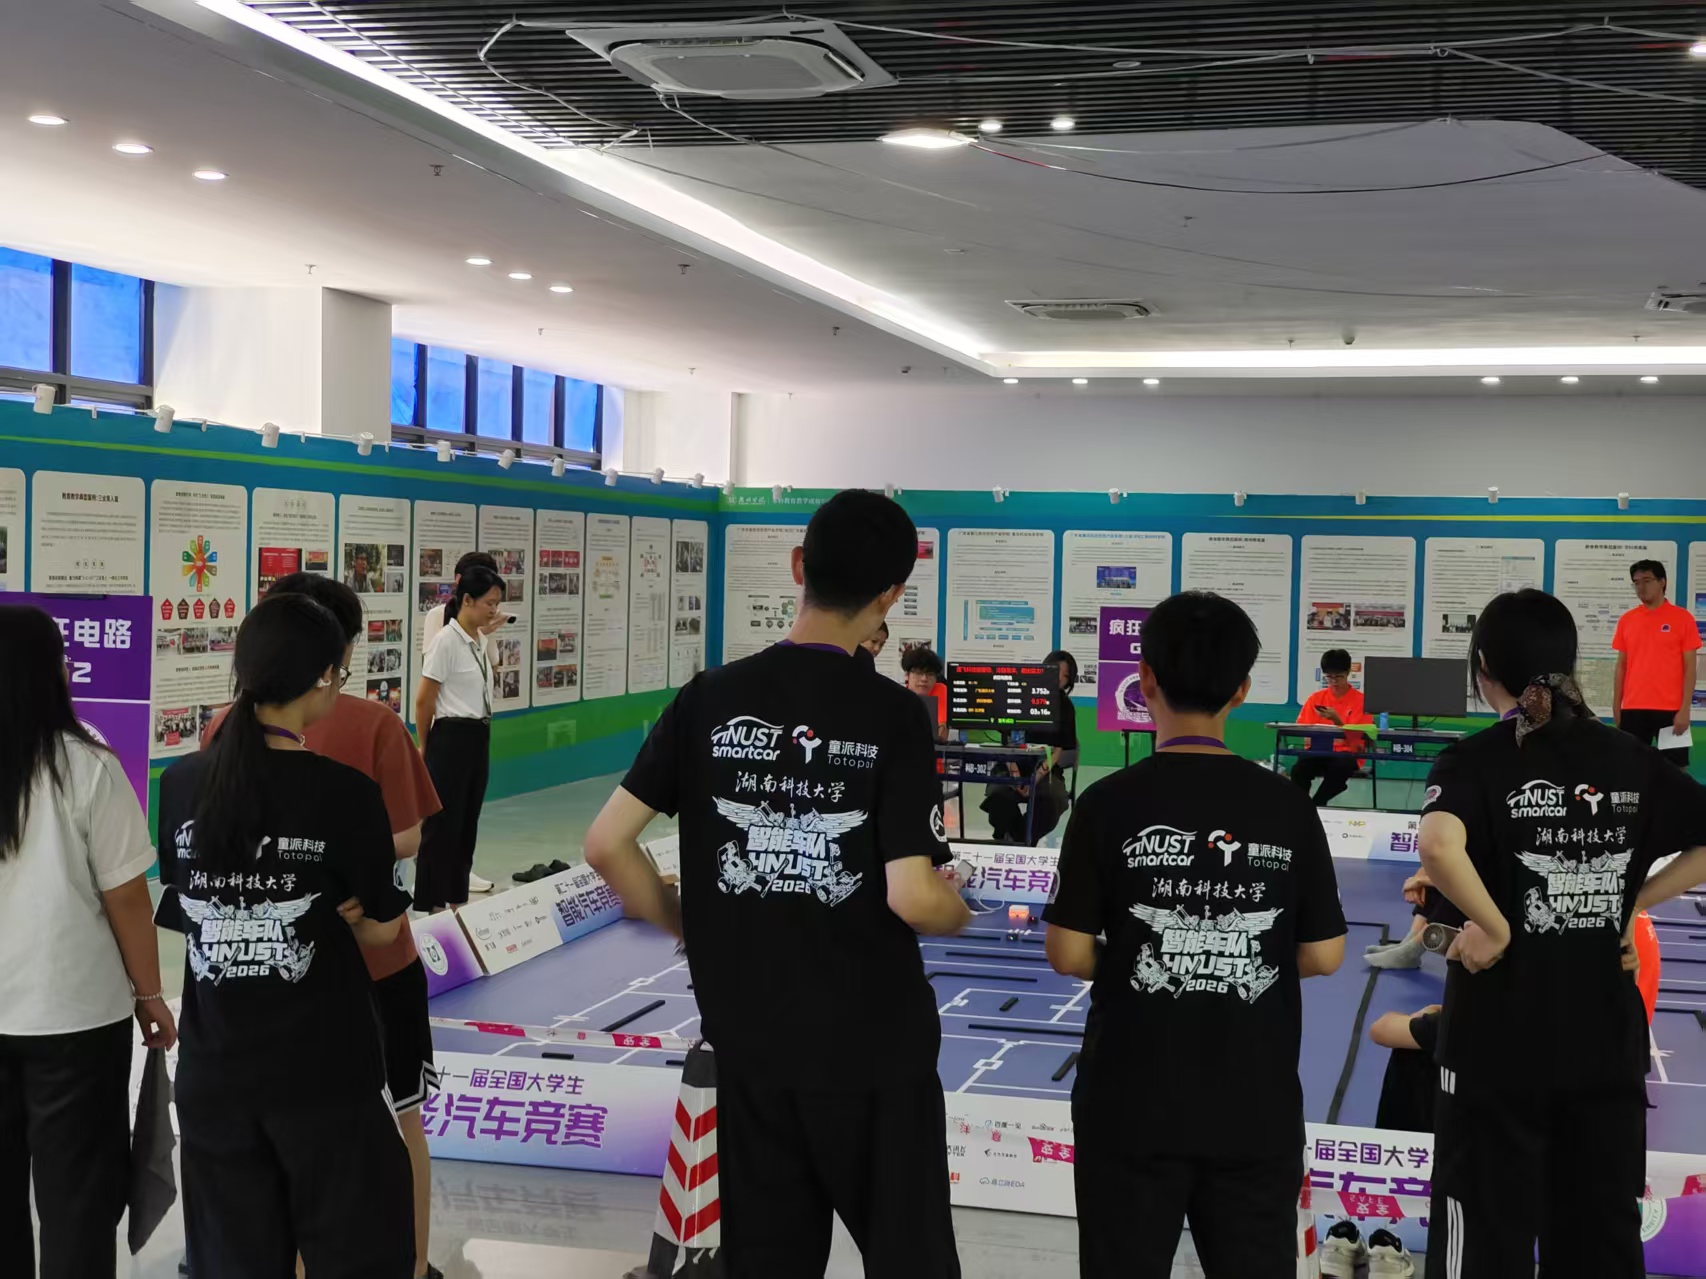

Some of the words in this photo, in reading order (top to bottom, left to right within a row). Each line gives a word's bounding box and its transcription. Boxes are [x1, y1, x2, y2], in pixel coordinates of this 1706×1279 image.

[712, 746, 780, 761] smartcar
[828, 740, 879, 760] 童派科技
[735, 770, 846, 803] 湖南科技大学
[1610, 791, 1640, 804] 童派科技
[1510, 804, 1567, 819] smartcar
[277, 836, 326, 853] 童派科技
[746, 825, 827, 859] 智能车队
[1535, 826, 1627, 847] 湖南科技大学
[1127, 854, 1195, 868] smartcar
[1247, 842, 1293, 863] 童派科技
[189, 870, 297, 892] 湖南科技大学
[1152, 877, 1266, 902] 湖南科技大学
[1547, 870, 1618, 895] 智能车队
[200, 919, 284, 943] 智能车队
[1567, 916, 1607, 929] 2026
[1160, 928, 1248, 957] 智能车队
[226, 964, 271, 979] 2026
[1185, 978, 1230, 994] 2026
